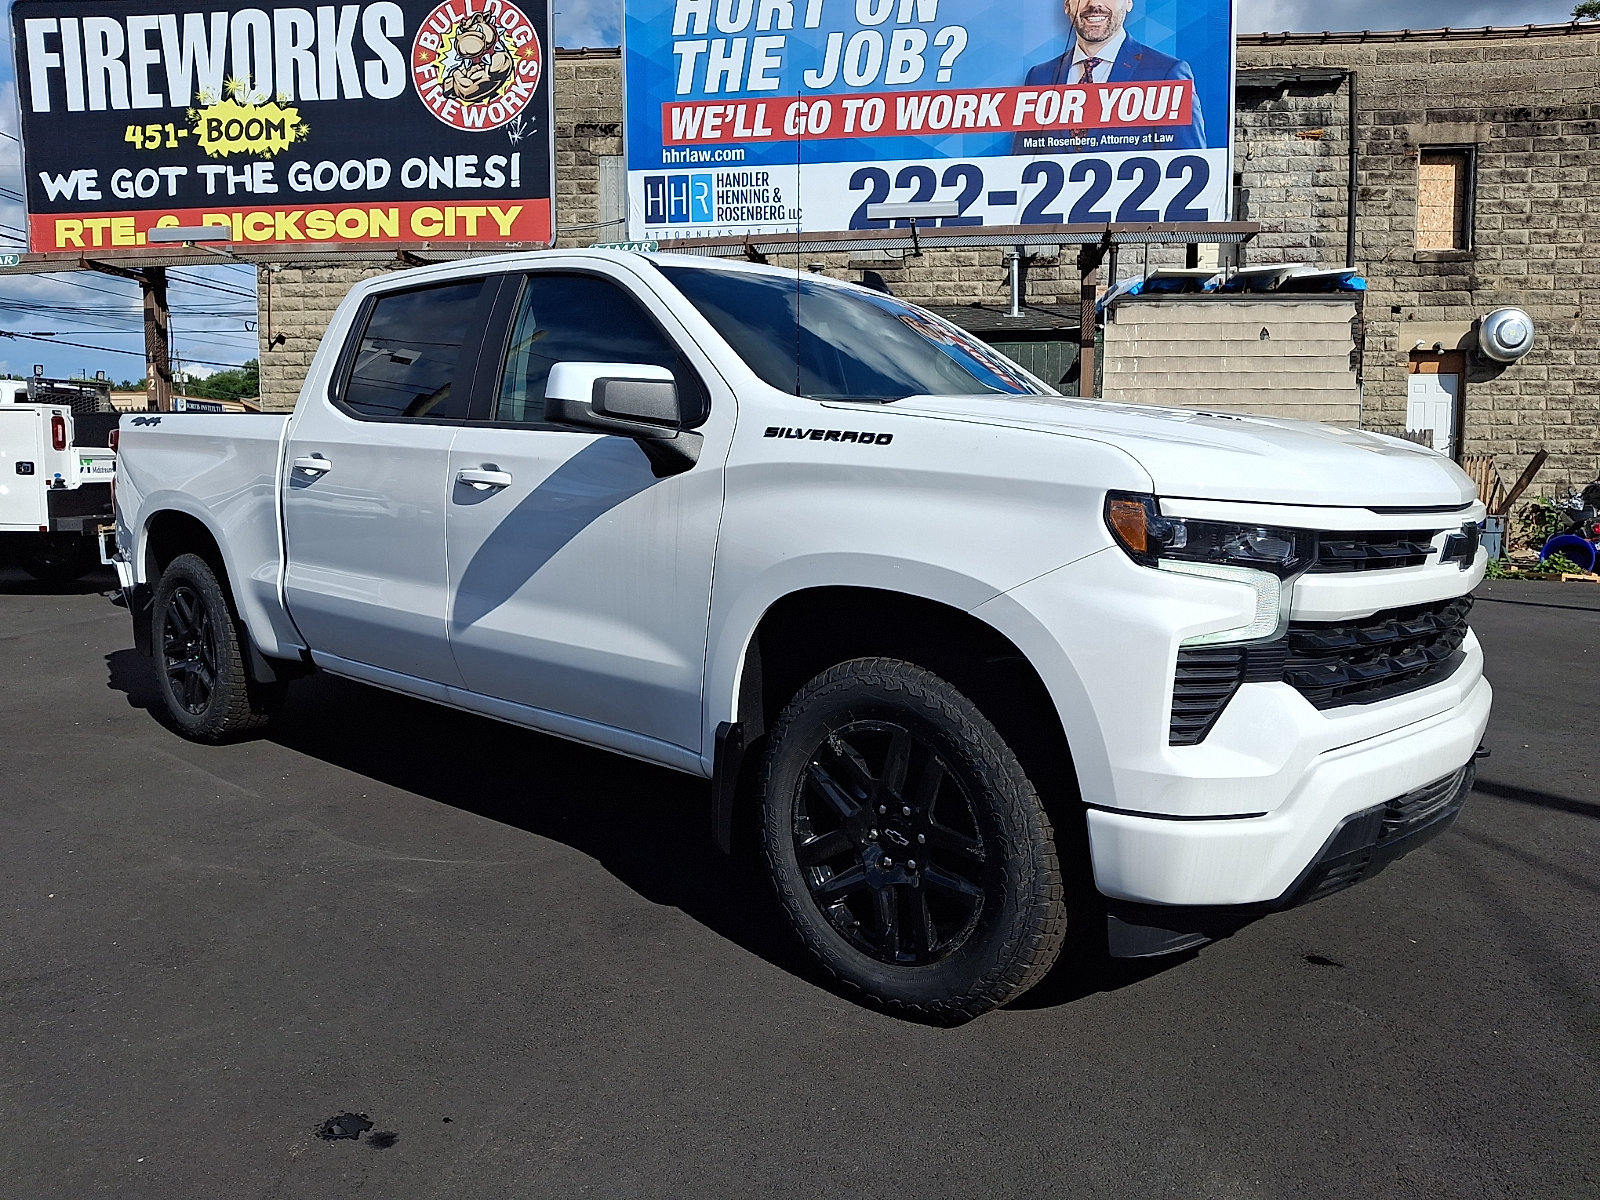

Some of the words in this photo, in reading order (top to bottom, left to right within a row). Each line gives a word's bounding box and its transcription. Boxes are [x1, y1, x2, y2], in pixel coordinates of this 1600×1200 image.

[418, 0, 533, 52] BULLDOG
[24, 1, 407, 113] FIREWORKS
[672, 35, 787, 95] THE
[803, 25, 969, 89] JOB?
[415, 60, 538, 128] FIREWORKS
[670, 102, 773, 141] WE'LL
[783, 98, 833, 136] GO
[841, 96, 886, 134] TO
[896, 92, 1006, 132] WORK
[1013, 88, 1087, 128] FOR
[1097, 85, 1185, 125] YOU!
[662, 147, 745, 164] hhrlaw.com
[1023, 137, 1046, 148] Matt
[1047, 135, 1099, 148] Rosenberg,
[1100, 134, 1140, 147] Attorney
[1142, 134, 1152, 143] at
[1154, 133, 1175, 143] Law
[39, 168, 103, 202] WE
[110, 165, 188, 200] GOT
[197, 161, 279, 196] THE
[287, 158, 392, 192] GOOD
[400, 151, 521, 190] ONES!
[716, 171, 770, 189] HANDLER
[848, 154, 1211, 231] 222-2222
[645, 180, 711, 217] HHR
[716, 189, 770, 205] HENNING
[772, 187, 782, 203] &
[716, 204, 785, 222] ROSENBERG
[788, 207, 803, 220] LLC
[55, 216, 147, 248] RTE.
[410, 205, 524, 238] CITY
[645, 230, 734, 240] ATTORNEYS
[595, 242, 651, 252] MAR
[763, 426, 894, 446] SILVERADO
